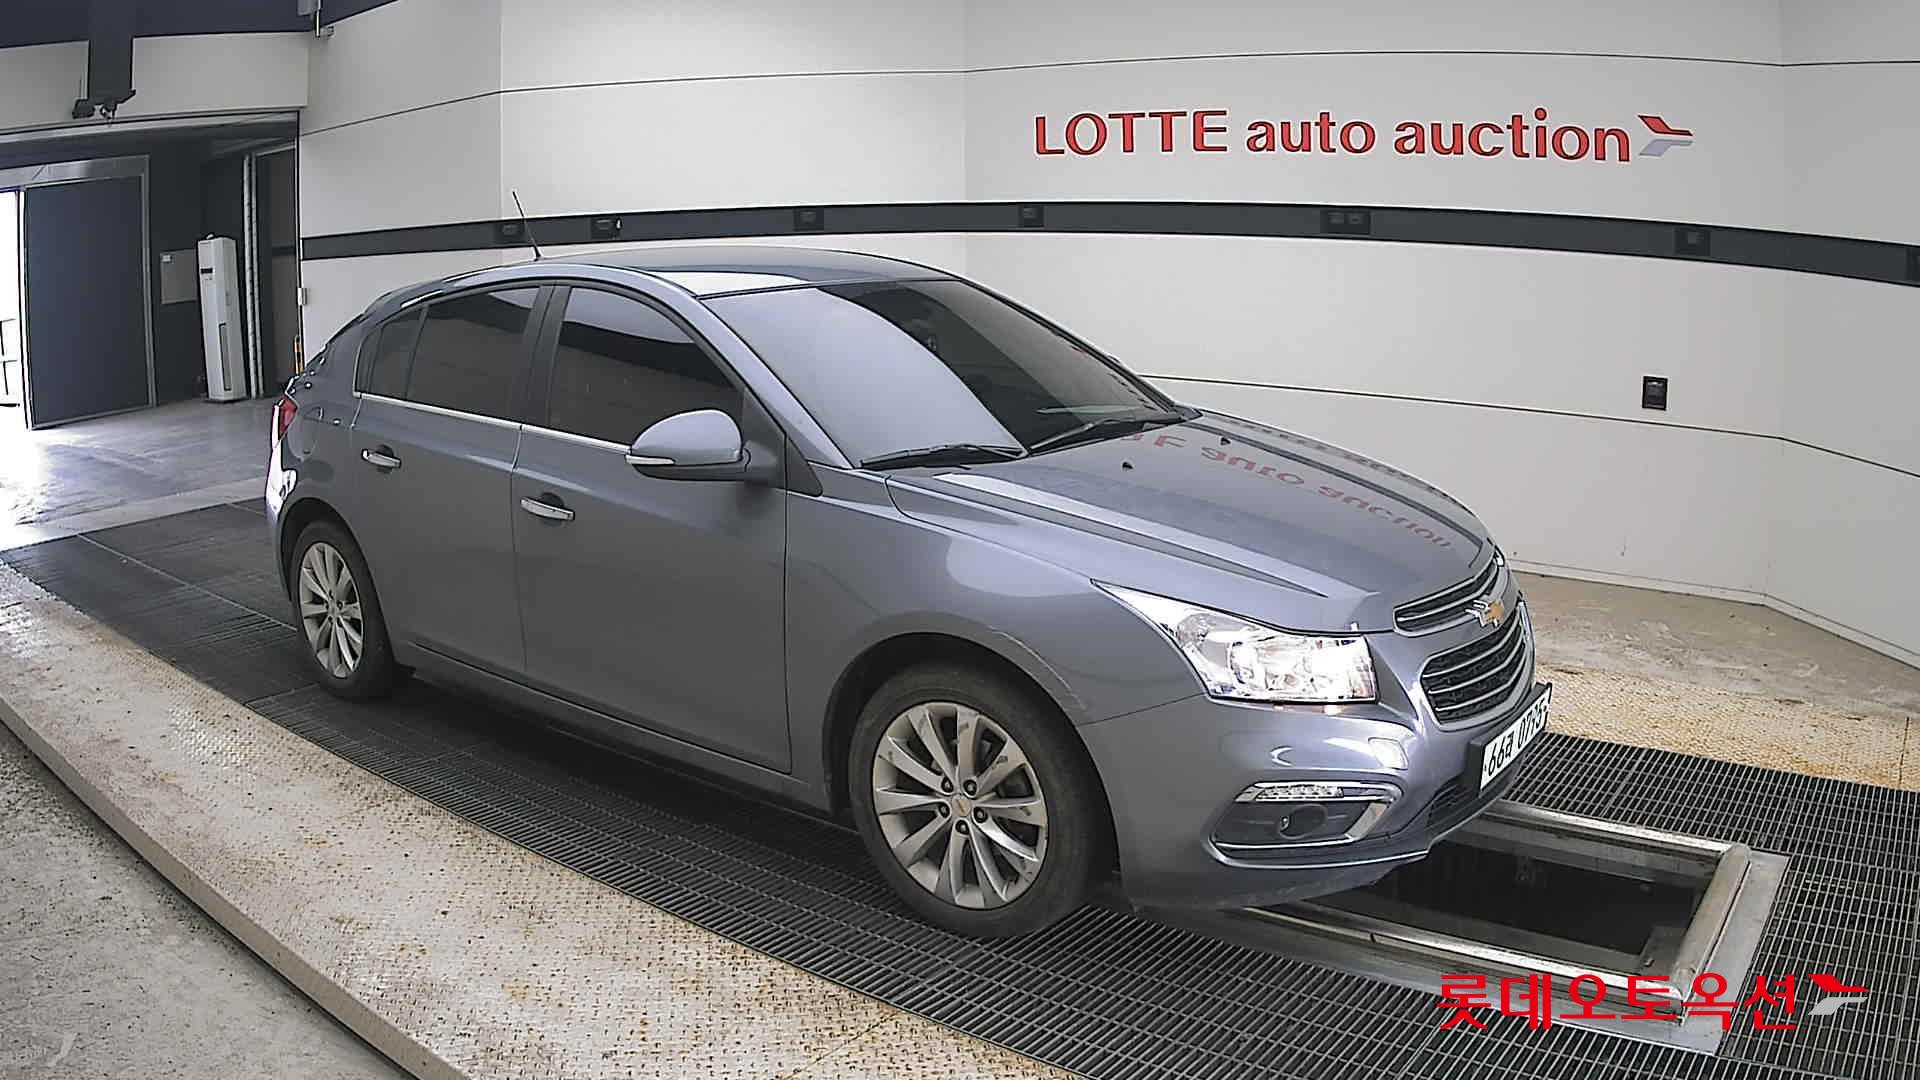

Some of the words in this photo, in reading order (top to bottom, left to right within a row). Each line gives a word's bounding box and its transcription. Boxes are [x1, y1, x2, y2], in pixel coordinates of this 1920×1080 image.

[1035, 109, 1228, 156] LOTTE
[1246, 111, 1377, 155] auto
[1393, 107, 1631, 162] auction
